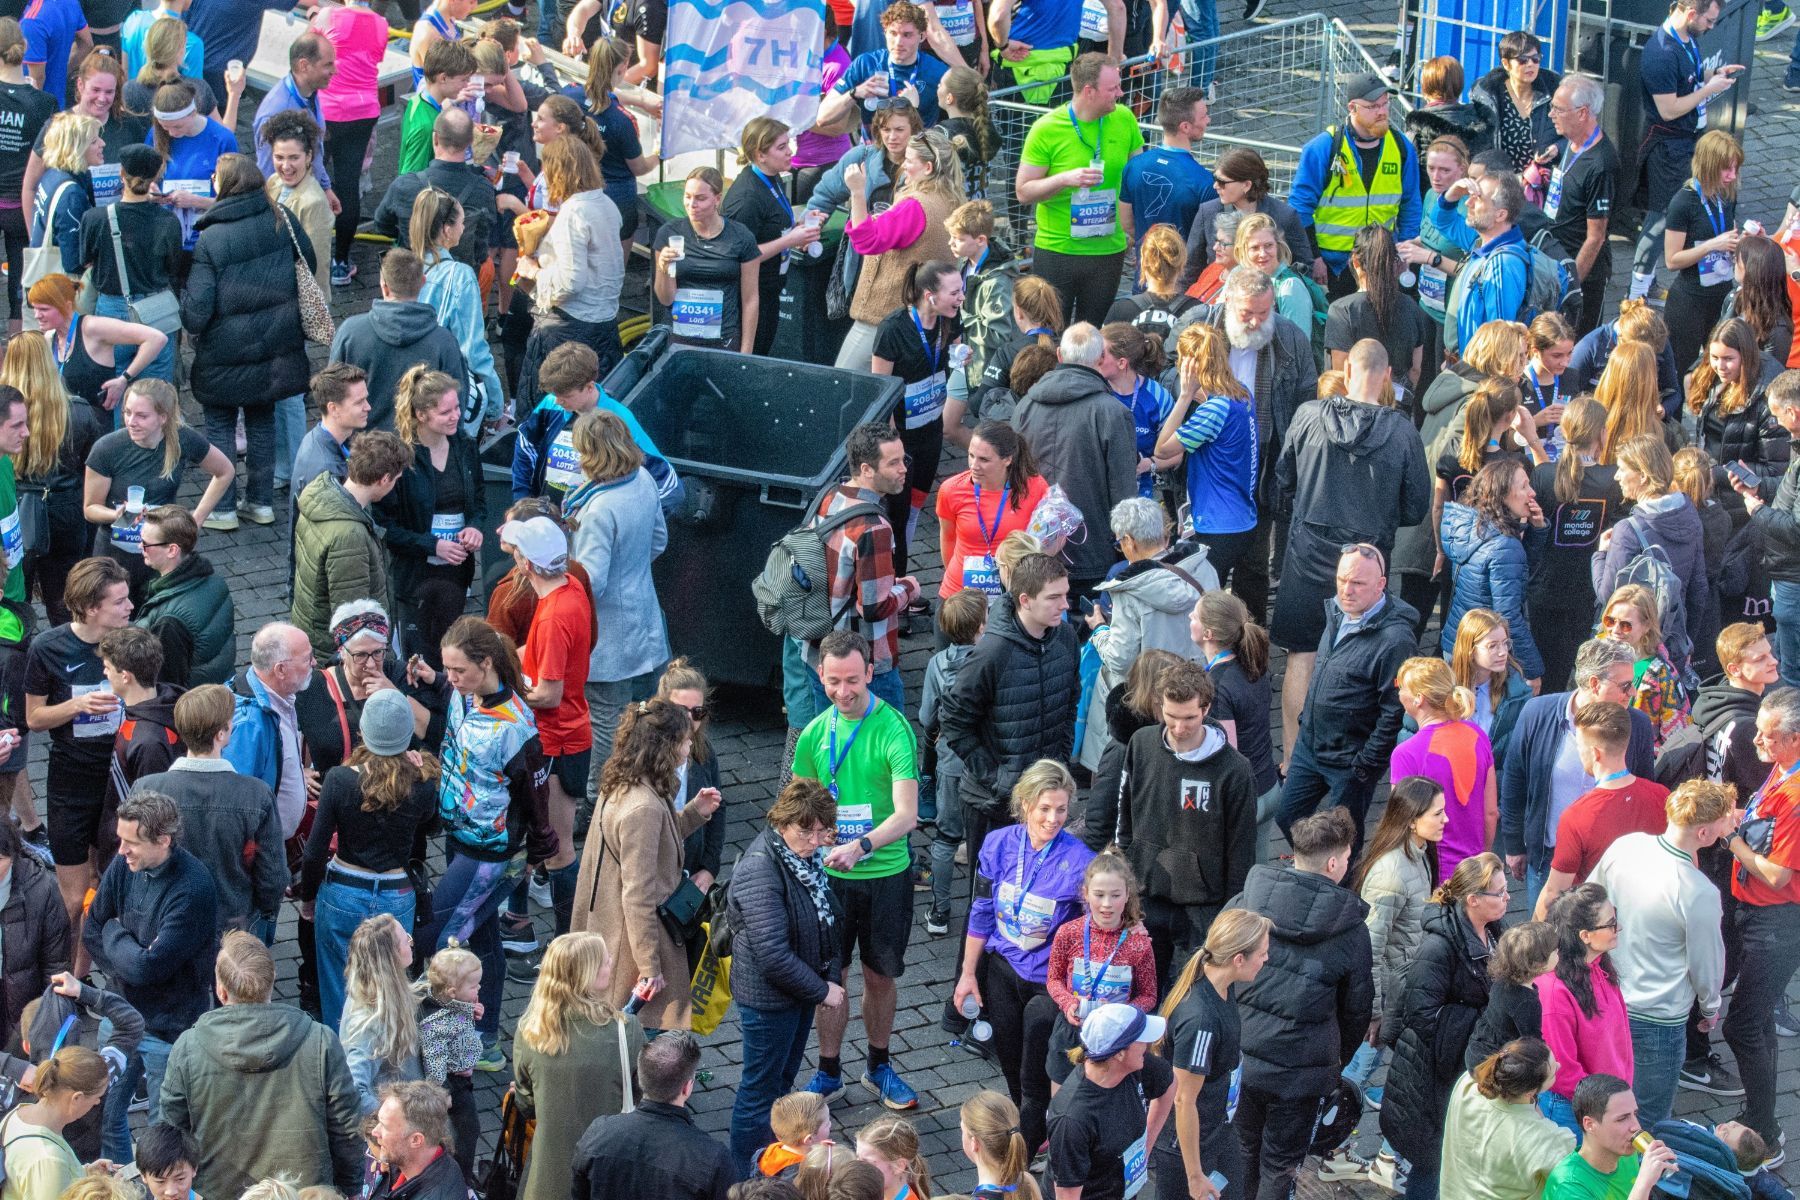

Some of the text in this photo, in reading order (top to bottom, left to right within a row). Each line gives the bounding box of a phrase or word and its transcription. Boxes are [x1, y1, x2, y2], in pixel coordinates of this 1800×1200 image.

[744, 37, 798, 68] 7H
[1384, 165, 1396, 174] 7H
[92, 179, 119, 189] 0609
[1079, 205, 1110, 217] 20357
[680, 304, 714, 315] 20341
[556, 460, 575, 471] LOTTE
[971, 574, 1001, 584] 2045
